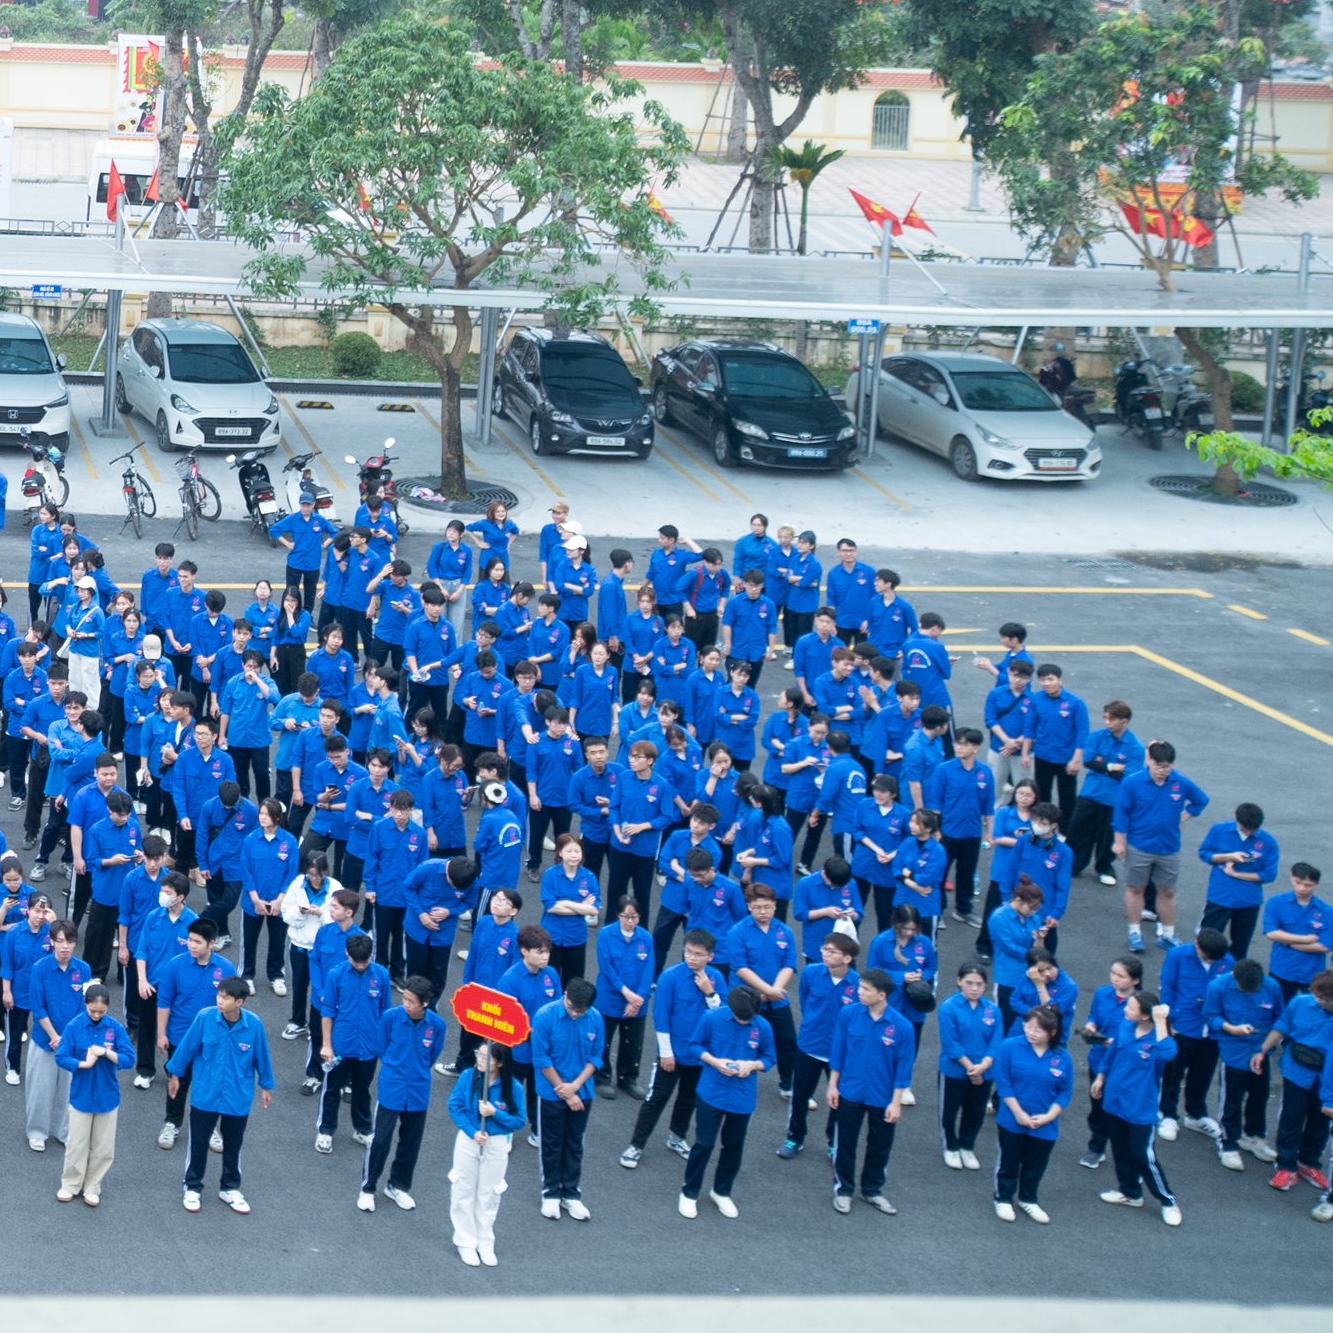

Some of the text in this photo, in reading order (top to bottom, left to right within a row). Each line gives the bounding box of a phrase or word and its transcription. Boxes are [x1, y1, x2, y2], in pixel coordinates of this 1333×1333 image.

[481, 1001, 502, 1017] KHỐI
[466, 1009, 515, 1035] THANH NIÊN
